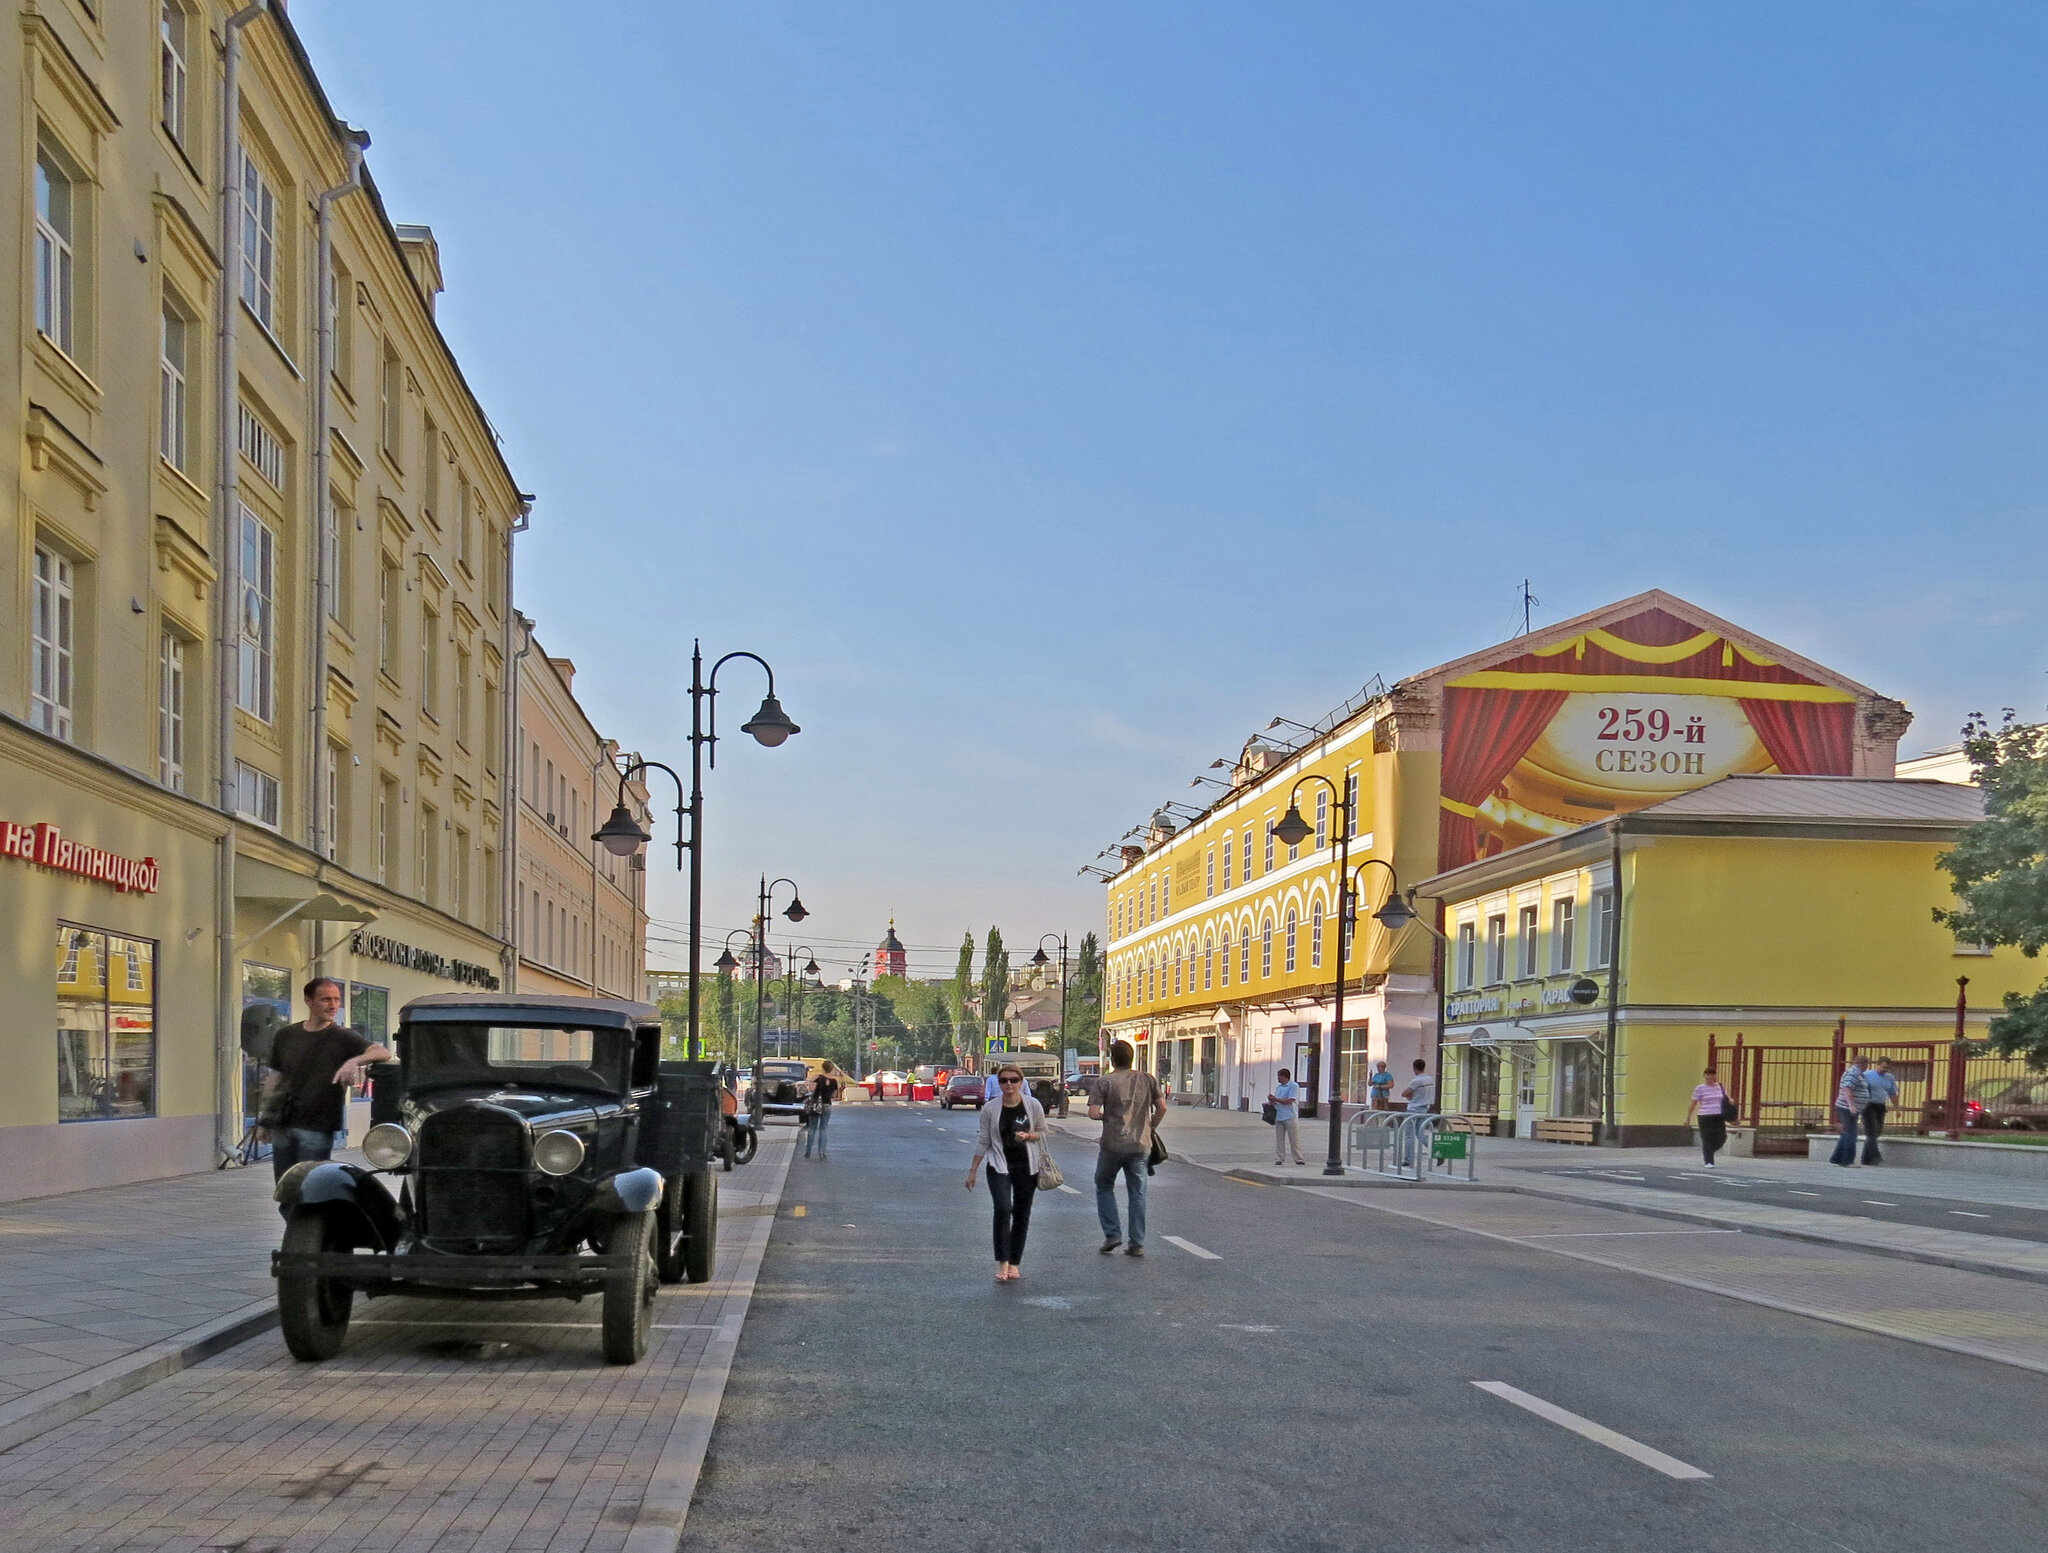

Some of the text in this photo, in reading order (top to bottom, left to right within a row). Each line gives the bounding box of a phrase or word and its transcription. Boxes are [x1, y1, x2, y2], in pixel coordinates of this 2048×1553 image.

[1597, 707, 1706, 744] 259-й
[1595, 749, 1705, 775] СЕЗОН
[4, 822, 160, 893] на Пятницкой
[1450, 997, 1498, 1016] ТРАТТОРИЯ
